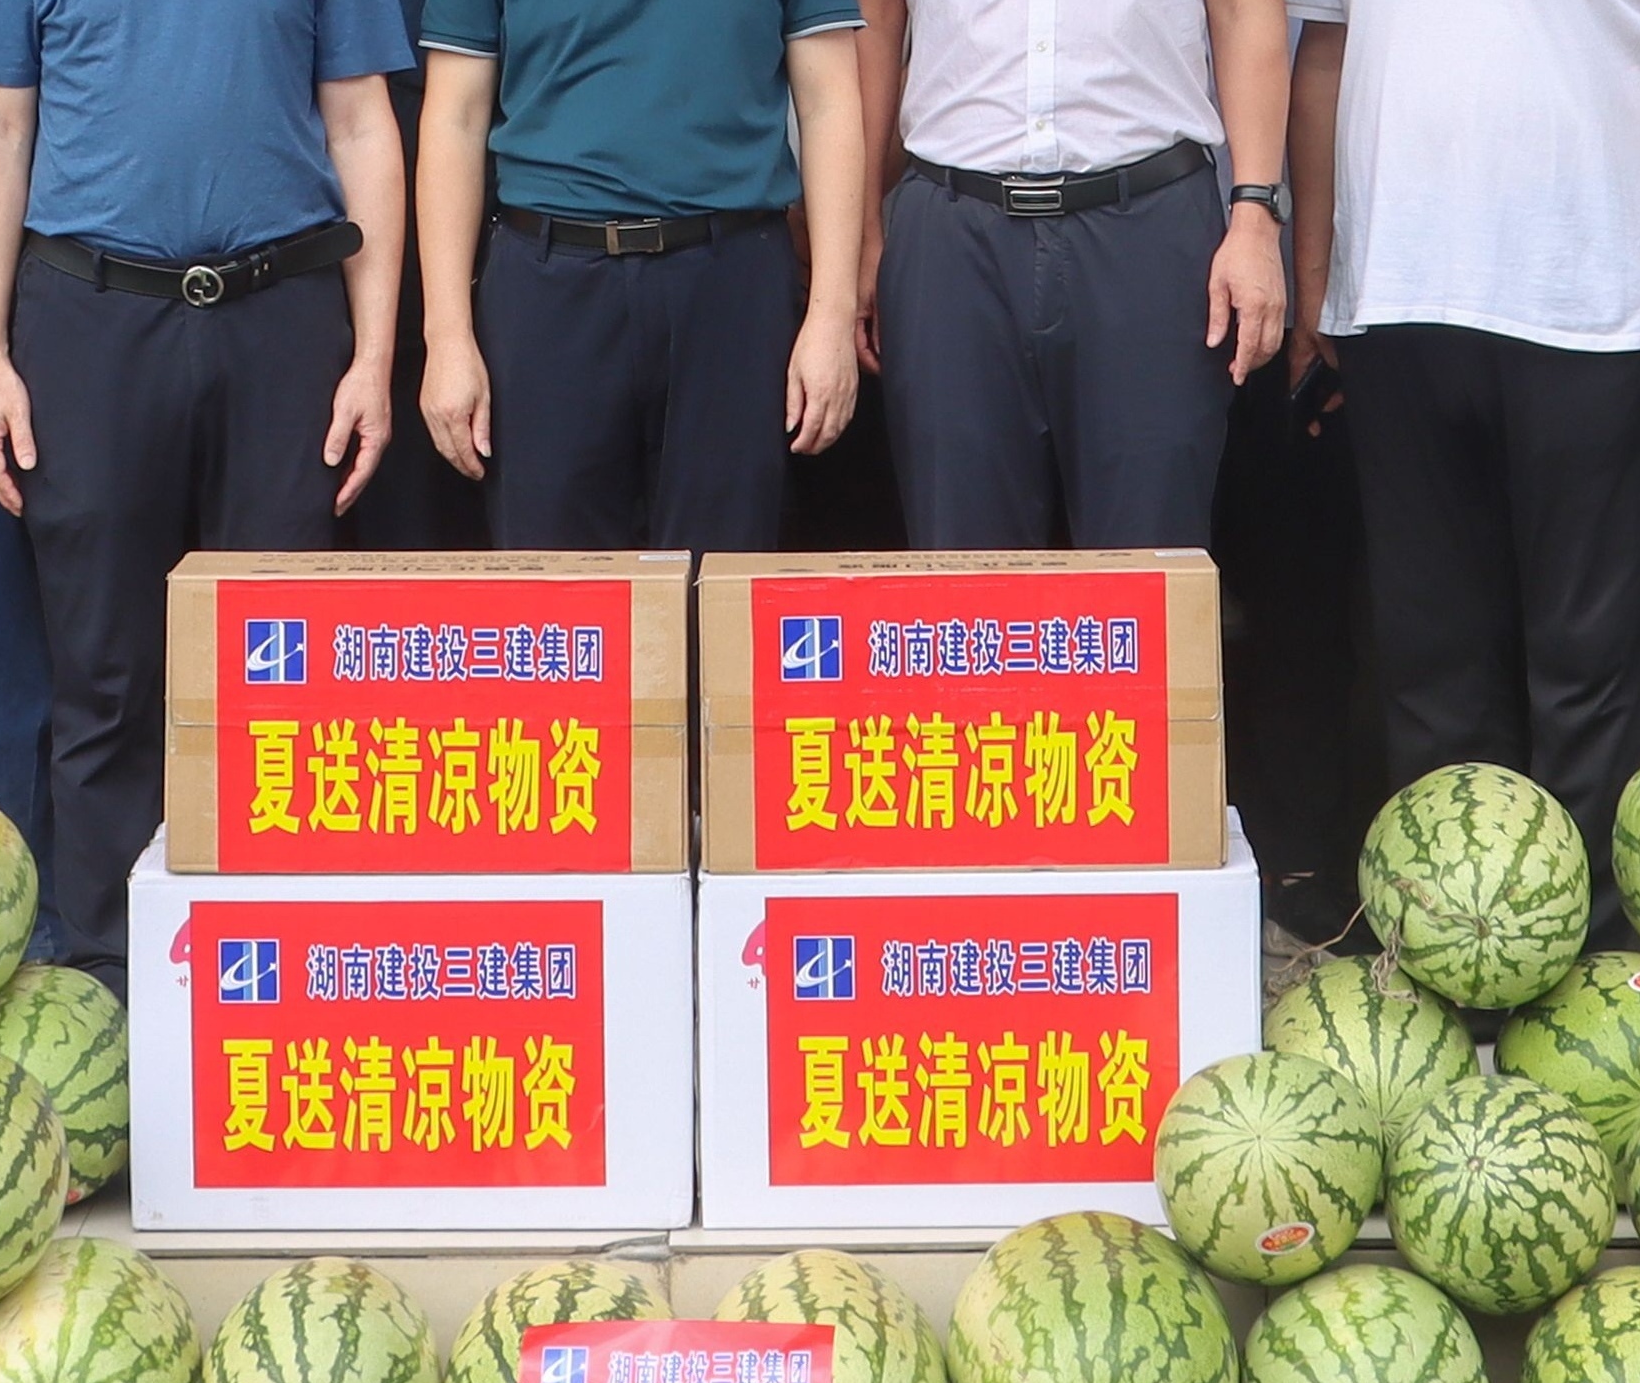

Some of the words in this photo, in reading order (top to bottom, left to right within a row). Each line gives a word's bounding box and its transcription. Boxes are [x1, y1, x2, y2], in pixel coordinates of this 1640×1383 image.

[335, 625, 601, 680] 湖南建投三建集团
[869, 618, 1137, 675] 湖南建投三建集团
[249, 718, 600, 834] 夏送清凉物资
[786, 710, 1137, 830] 夏送清凉物资
[307, 943, 575, 999] 湖南建投三建集团
[882, 939, 1150, 995] 湖南建投三建集团
[223, 1036, 575, 1151] 夏送清凉物资
[799, 1030, 1149, 1148] 夏送清凉物资
[608, 1350, 810, 1383] 湖南建投三建集团
